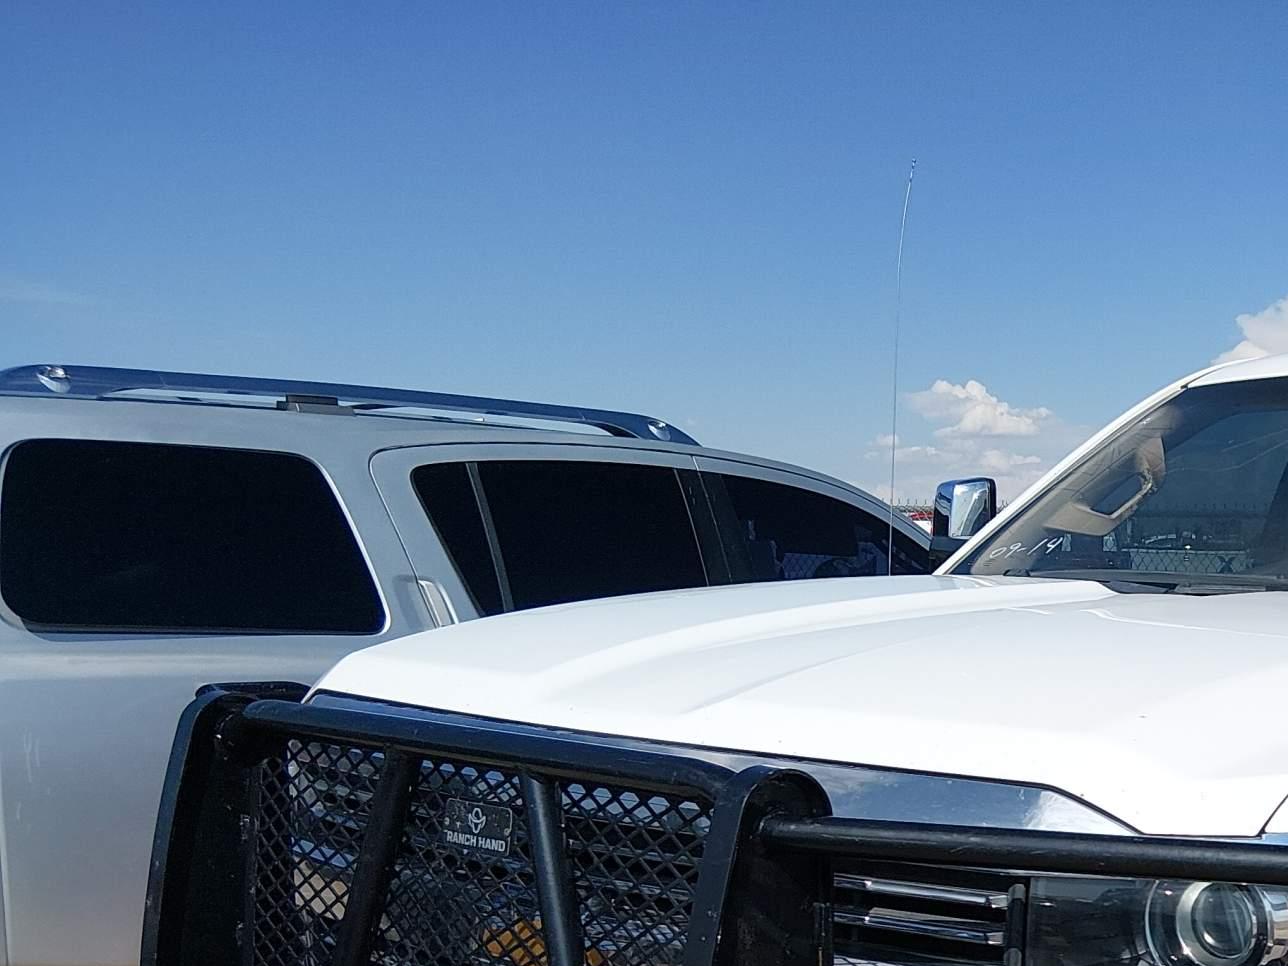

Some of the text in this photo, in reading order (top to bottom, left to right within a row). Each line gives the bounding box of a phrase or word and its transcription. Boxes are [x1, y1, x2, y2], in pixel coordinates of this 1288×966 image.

[989, 536, 1064, 559] 09-14
[444, 829, 506, 852] RANCH HAND
